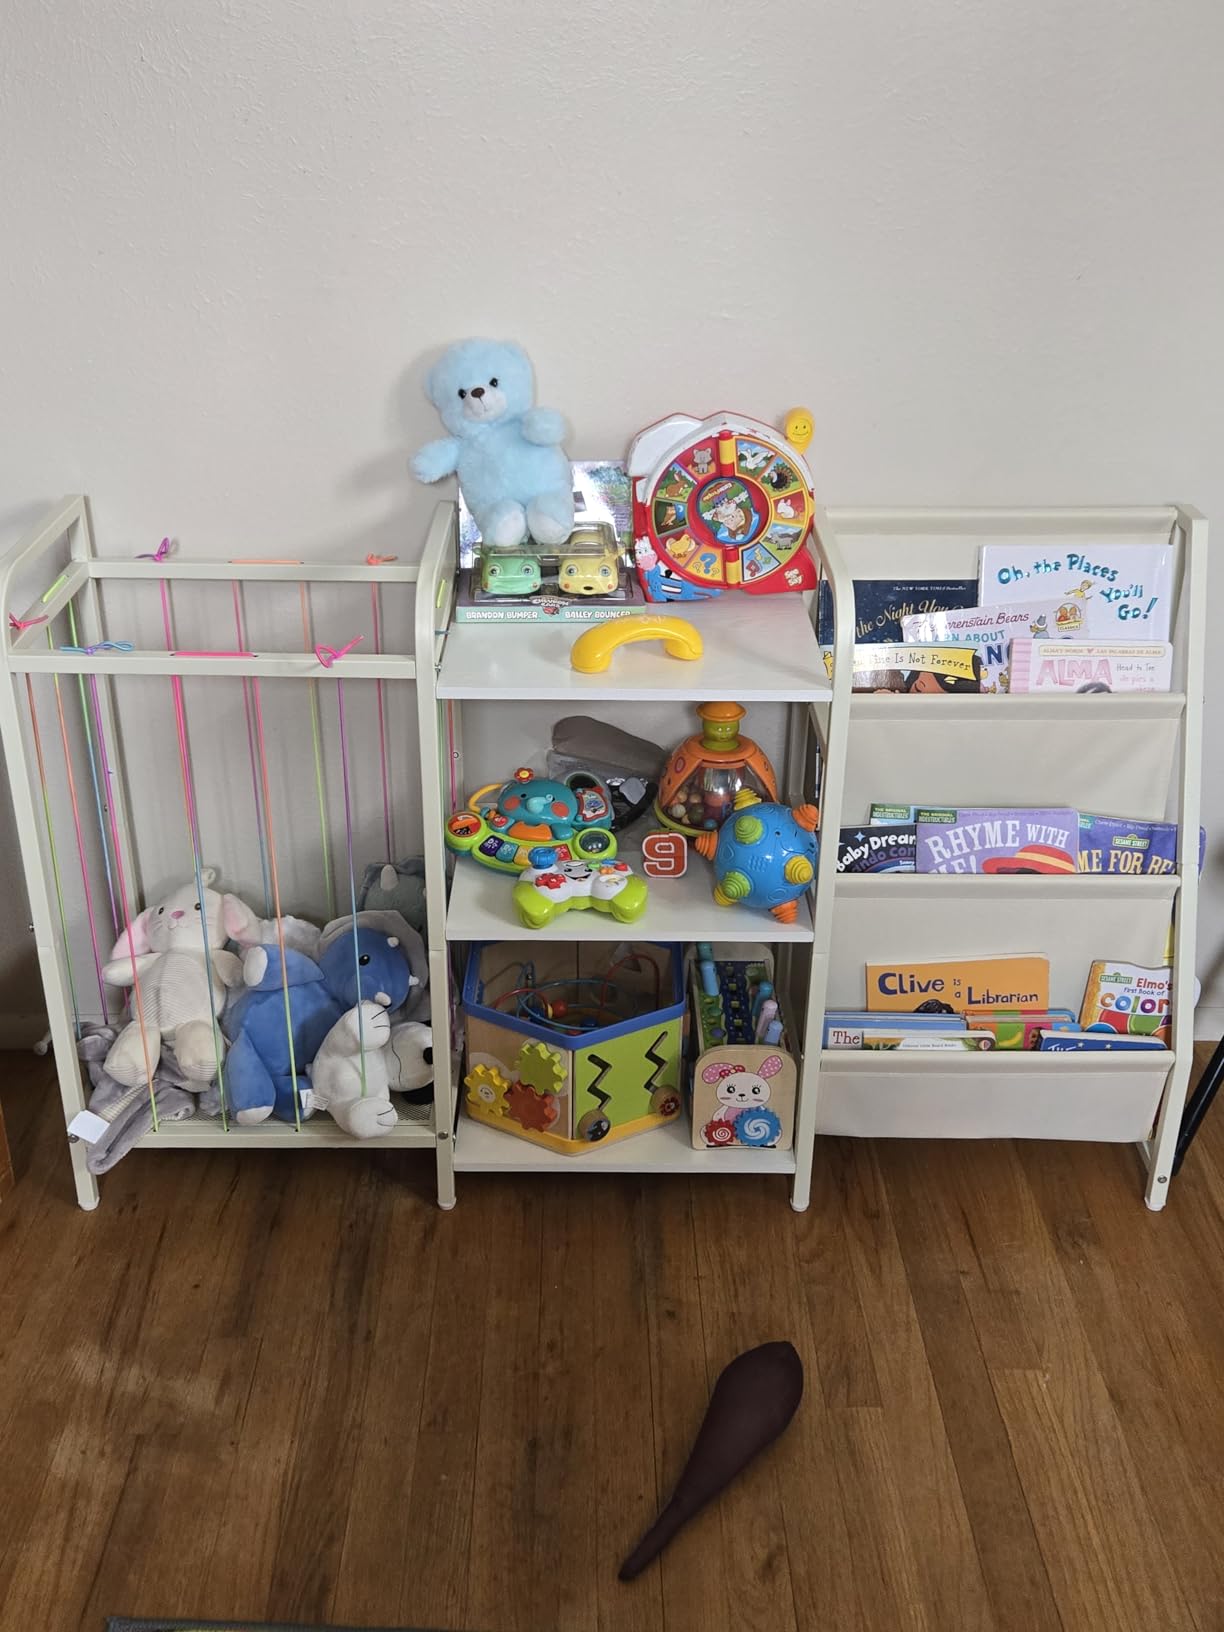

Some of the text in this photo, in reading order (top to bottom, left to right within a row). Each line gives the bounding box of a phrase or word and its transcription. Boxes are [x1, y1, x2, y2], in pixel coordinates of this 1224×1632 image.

[997, 553, 1119, 584] Oh, the Places
[1100, 583, 1144, 603] You'll
[996, 612, 1029, 625] Bears
[1117, 597, 1158, 620] Go!
[855, 618, 874, 638] the
[876, 602, 914, 628] Night
[965, 630, 1006, 643] ABOUT
[895, 653, 904, 663] Is
[908, 654, 926, 664] Not
[930, 655, 971, 671] Forever
[1036, 658, 1113, 687] ALMA
[1116, 663, 1133, 672] Head
[925, 820, 1070, 864] RHYME WITH
[642, 833, 688, 878] 9
[1108, 850, 1144, 875] FOR
[878, 972, 961, 996] Clive is
[1136, 977, 1173, 991] Elmo's
[954, 986, 1038, 1005] a Librarian
[832, 1030, 861, 1045] The
